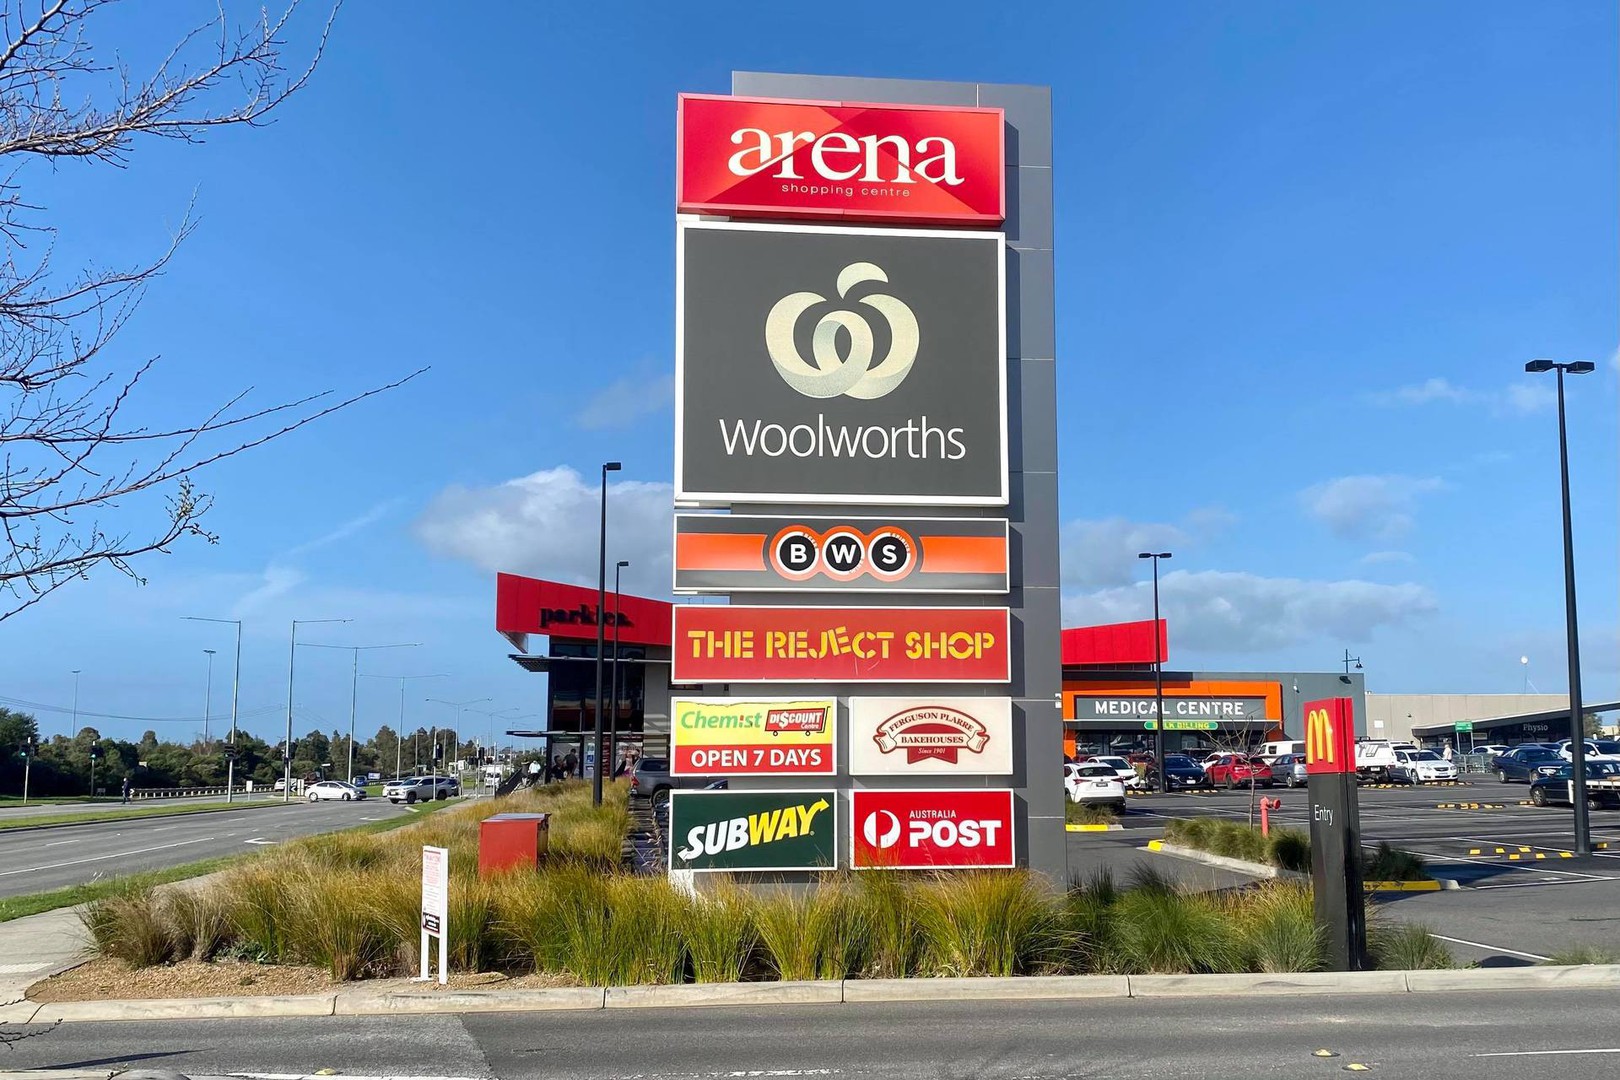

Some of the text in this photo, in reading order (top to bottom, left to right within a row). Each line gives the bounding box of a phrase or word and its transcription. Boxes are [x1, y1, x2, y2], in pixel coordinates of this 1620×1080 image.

[728, 127, 965, 186] arena
[781, 184, 911, 197] shopping centre
[719, 413, 966, 460] Woolworths
[687, 625, 995, 660] THE REJECT SHOP
[1095, 700, 1244, 715] MEDICAL CENTRE
[681, 711, 762, 729] Chemist
[889, 712, 975, 732] FERGUSON PLARRE
[1523, 723, 1549, 733] Physio
[901, 736, 964, 744] BAKEHOUSES
[691, 748, 822, 767] OPEN 7 DAYS
[909, 809, 957, 819] AUSTRALIA
[1314, 804, 1334, 826] Entry
[680, 800, 826, 861] SUBWAY
[909, 819, 1003, 848] POST
